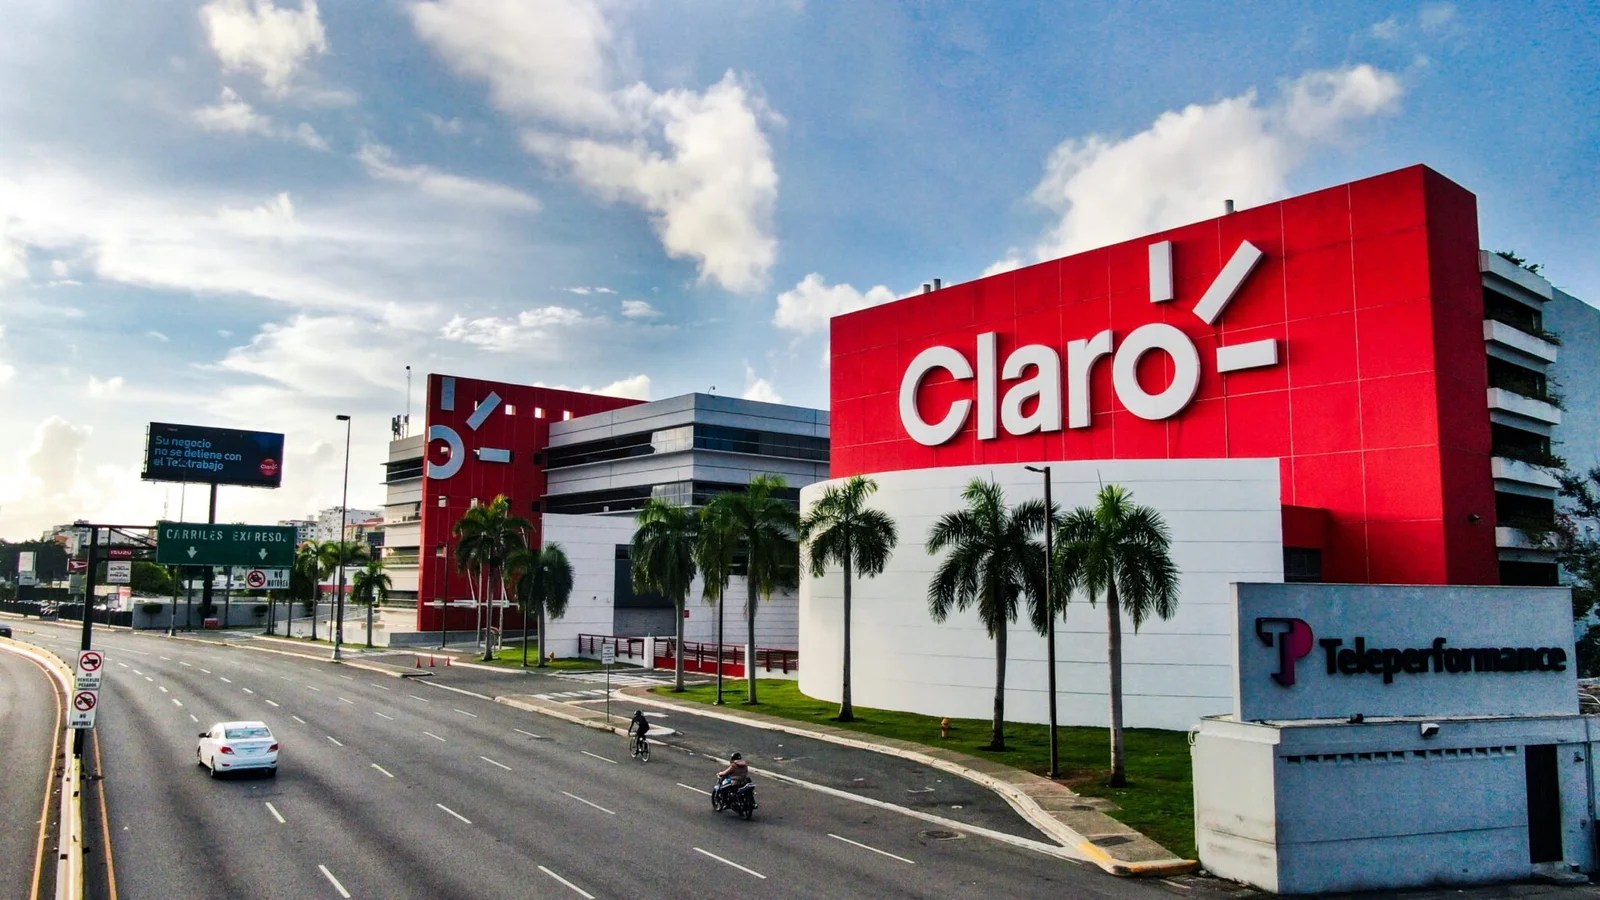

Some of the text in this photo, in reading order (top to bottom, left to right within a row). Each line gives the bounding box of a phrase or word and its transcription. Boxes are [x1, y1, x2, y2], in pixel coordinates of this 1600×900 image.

[899, 322, 1200, 446] Claro
[155, 435, 212, 449] Su negocio
[154, 448, 242, 461] no se detiene con
[153, 457, 164, 466] el
[274, 570, 283, 578] NO
[1319, 637, 1567, 684] Teleperformance
